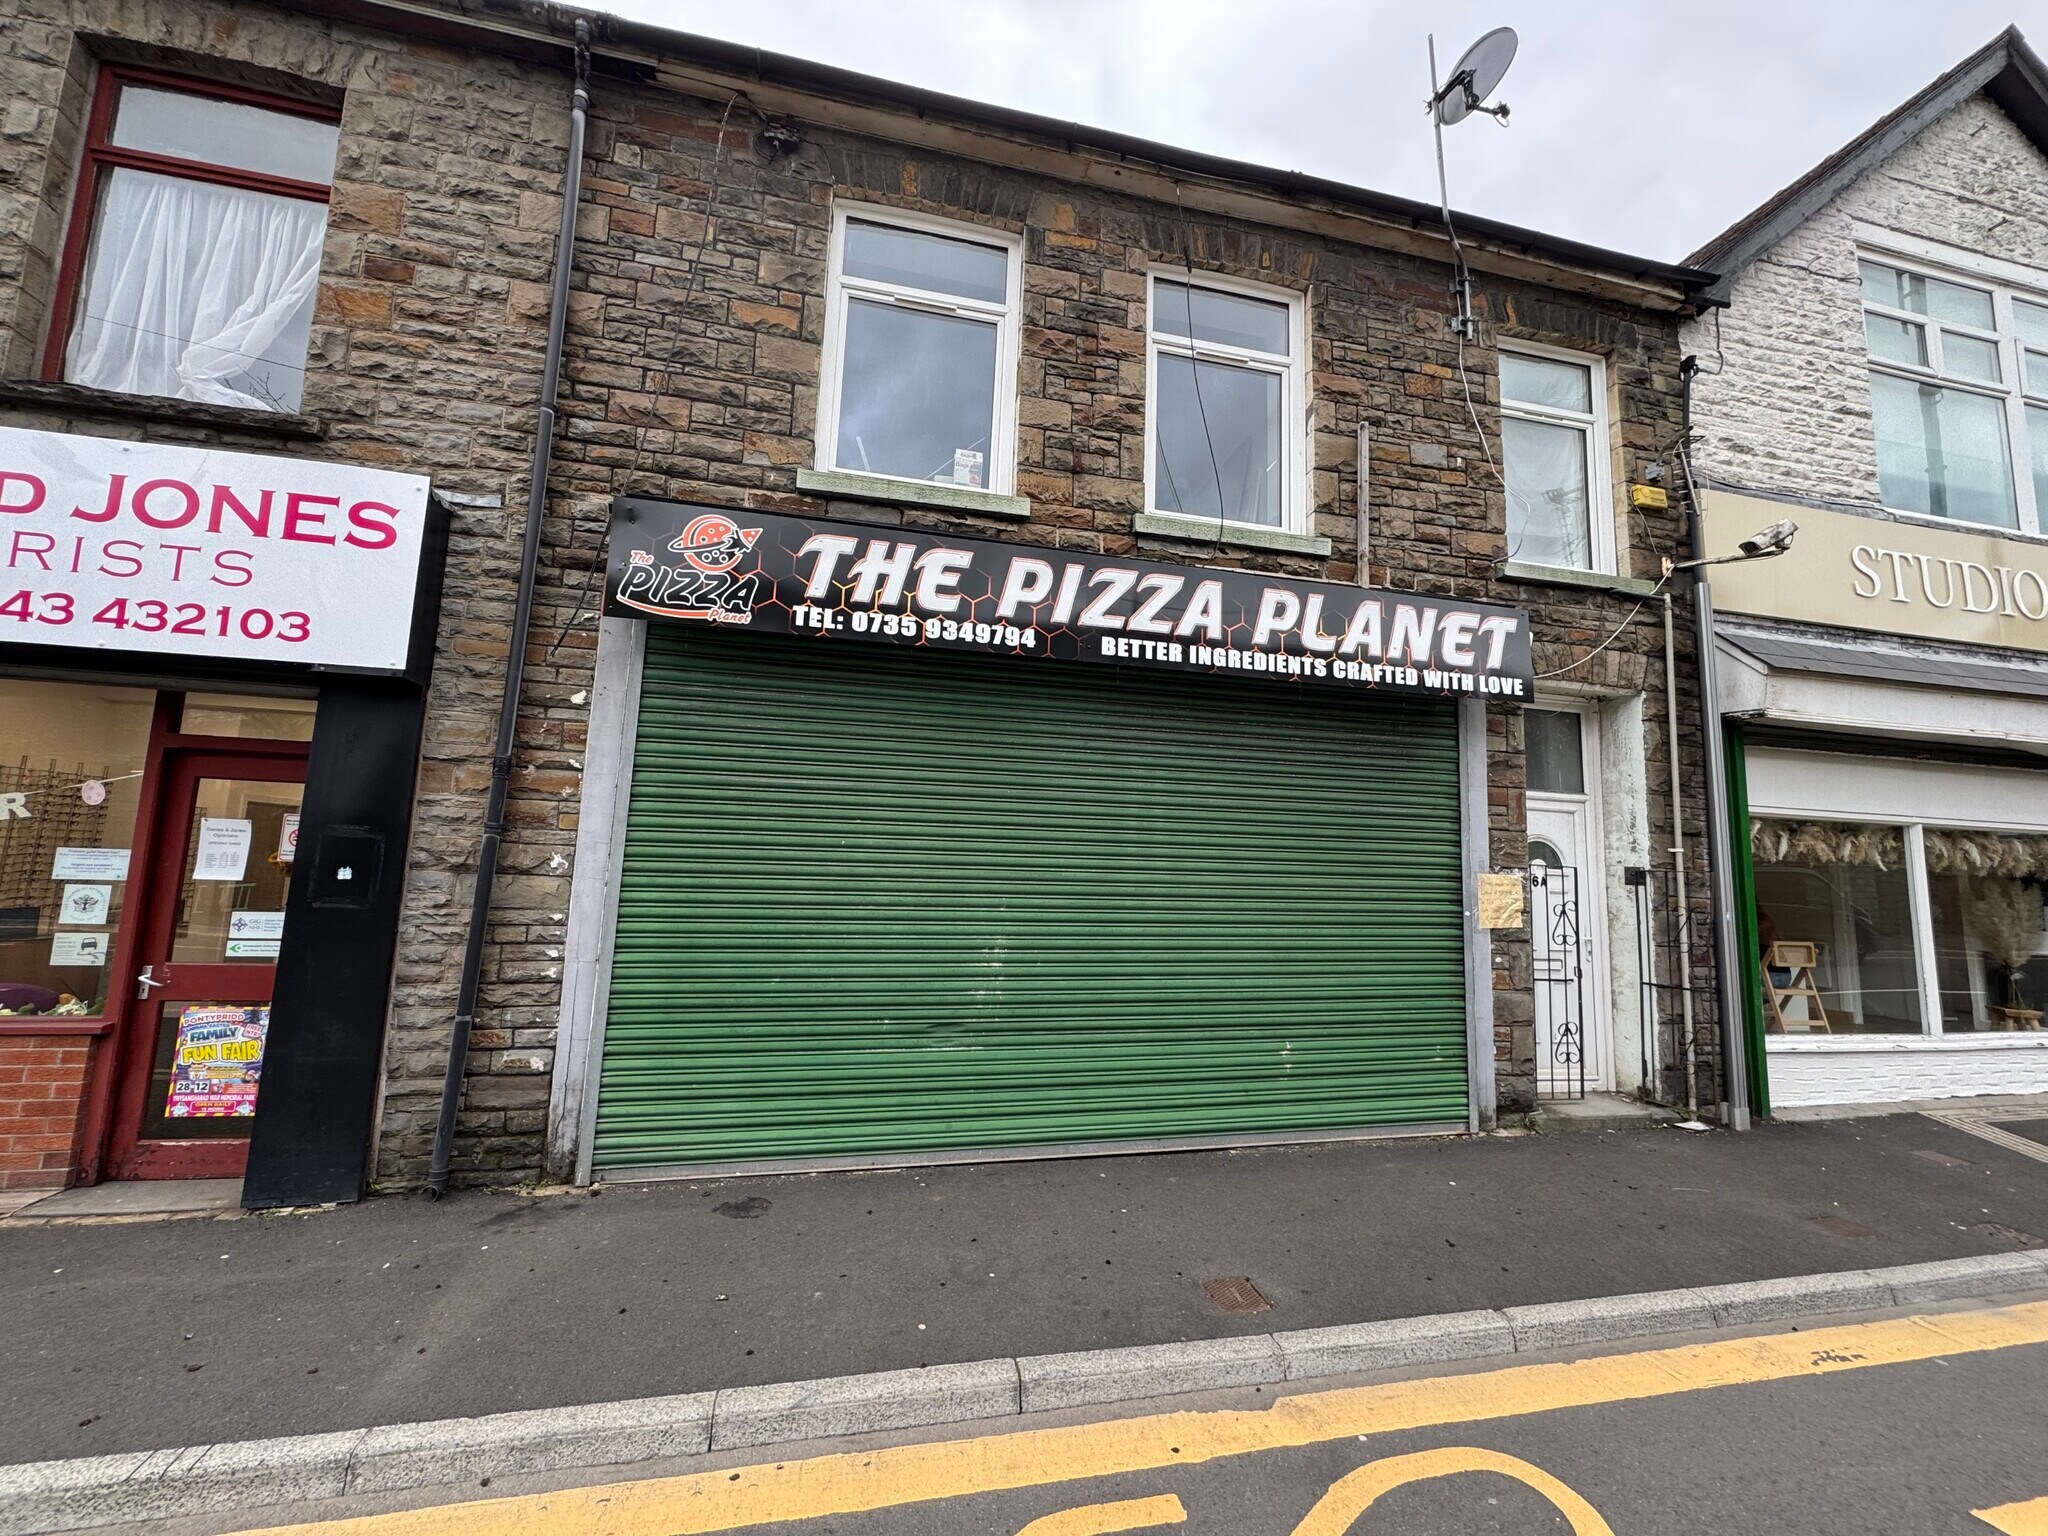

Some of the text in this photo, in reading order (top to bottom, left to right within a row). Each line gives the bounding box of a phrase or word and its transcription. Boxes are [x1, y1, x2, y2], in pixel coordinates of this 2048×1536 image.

[70, 473, 401, 550] JONES
[7, 530, 255, 587] RISTS
[629, 550, 654, 566] The
[1851, 544, 2048, 621] STUDIO
[617, 563, 760, 612] PIZZA
[797, 533, 1519, 670] THE PIZZA PLANET
[0, 590, 312, 643] 43 432103
[707, 607, 752, 625] Planet
[792, 604, 1037, 648] TEL: 0735 9349794
[1100, 636, 1525, 696] BETTER INGREDIENTS CRAFTED WITH LOVE
[184, 1014, 244, 1025] PONTYPRIDD
[190, 1027, 240, 1043] FAMILY
[182, 1040, 261, 1064] FUN FAIR
